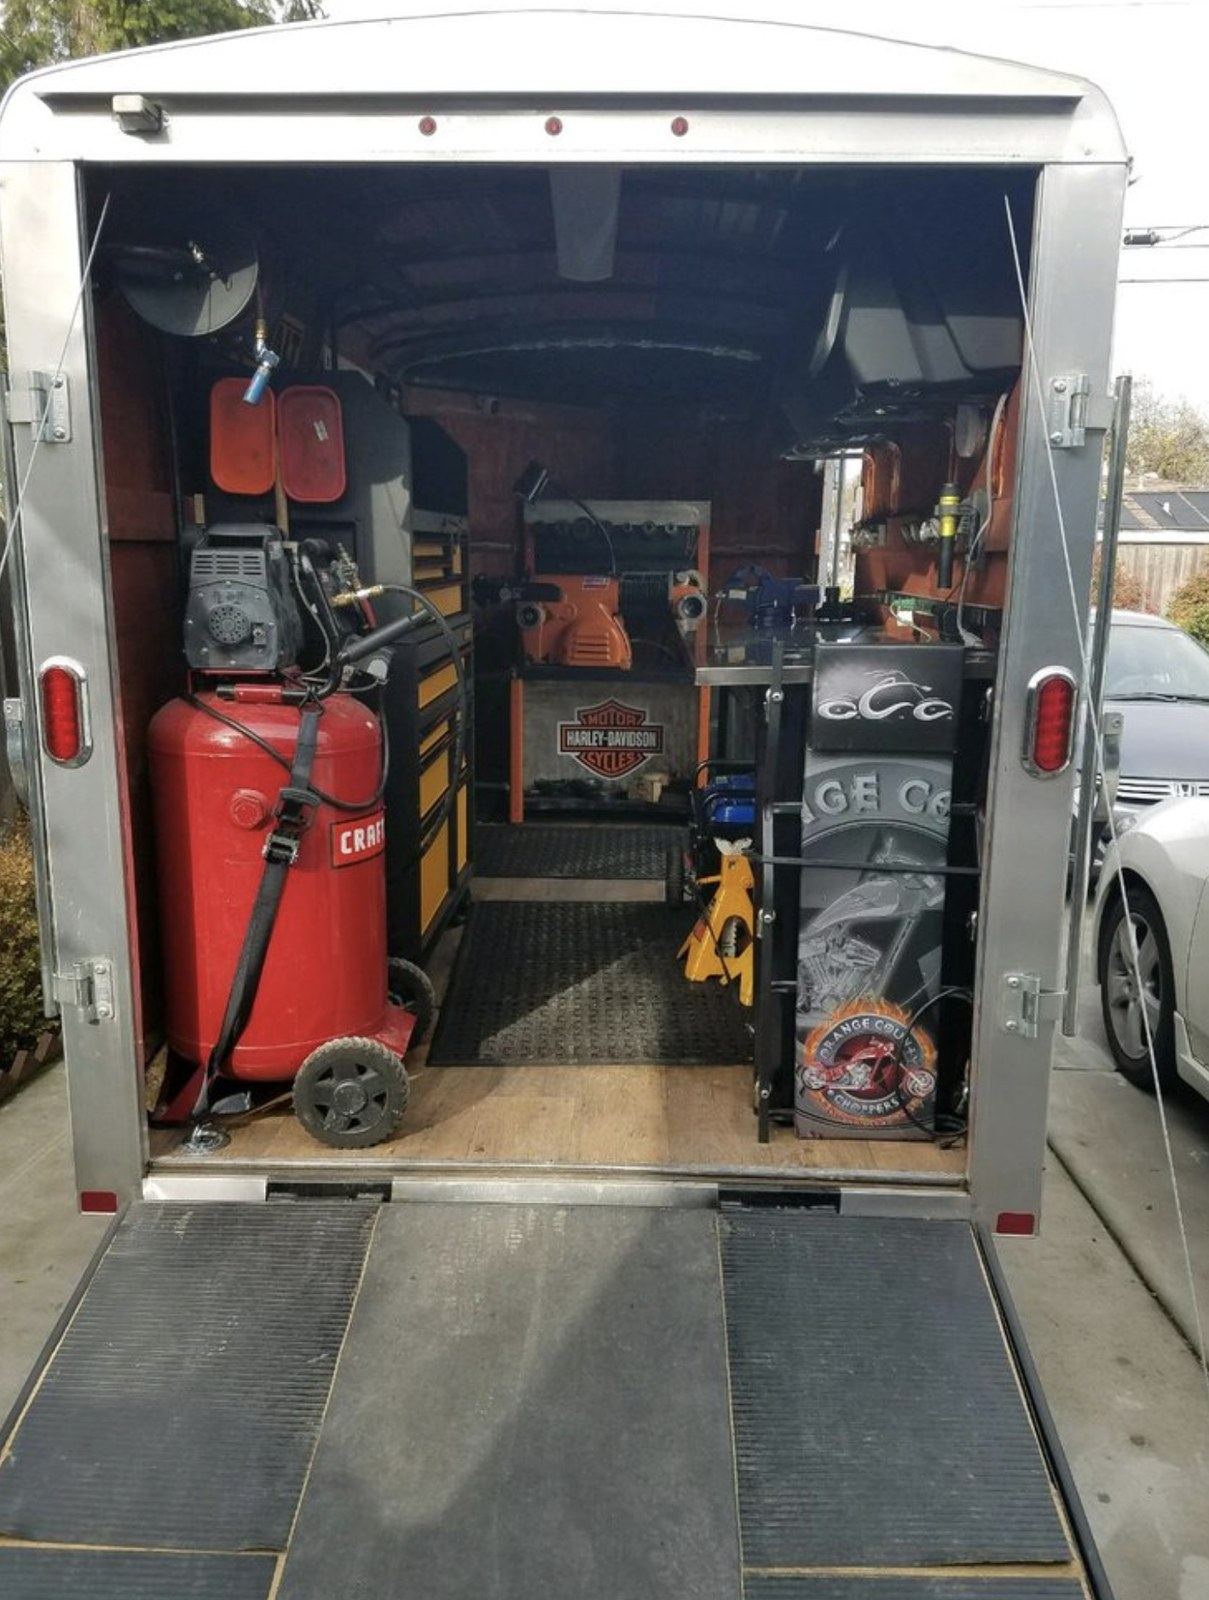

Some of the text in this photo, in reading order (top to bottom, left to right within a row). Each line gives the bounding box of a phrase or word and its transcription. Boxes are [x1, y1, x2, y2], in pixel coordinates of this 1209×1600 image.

[586, 711, 637, 726] MOTOR
[566, 729, 657, 748] HARLEY-DAVIDSON
[586, 751, 637, 771] CYCLES
[820, 1018, 870, 1059] ORANGE
[834, 1095, 900, 1115] CHOPPERS
